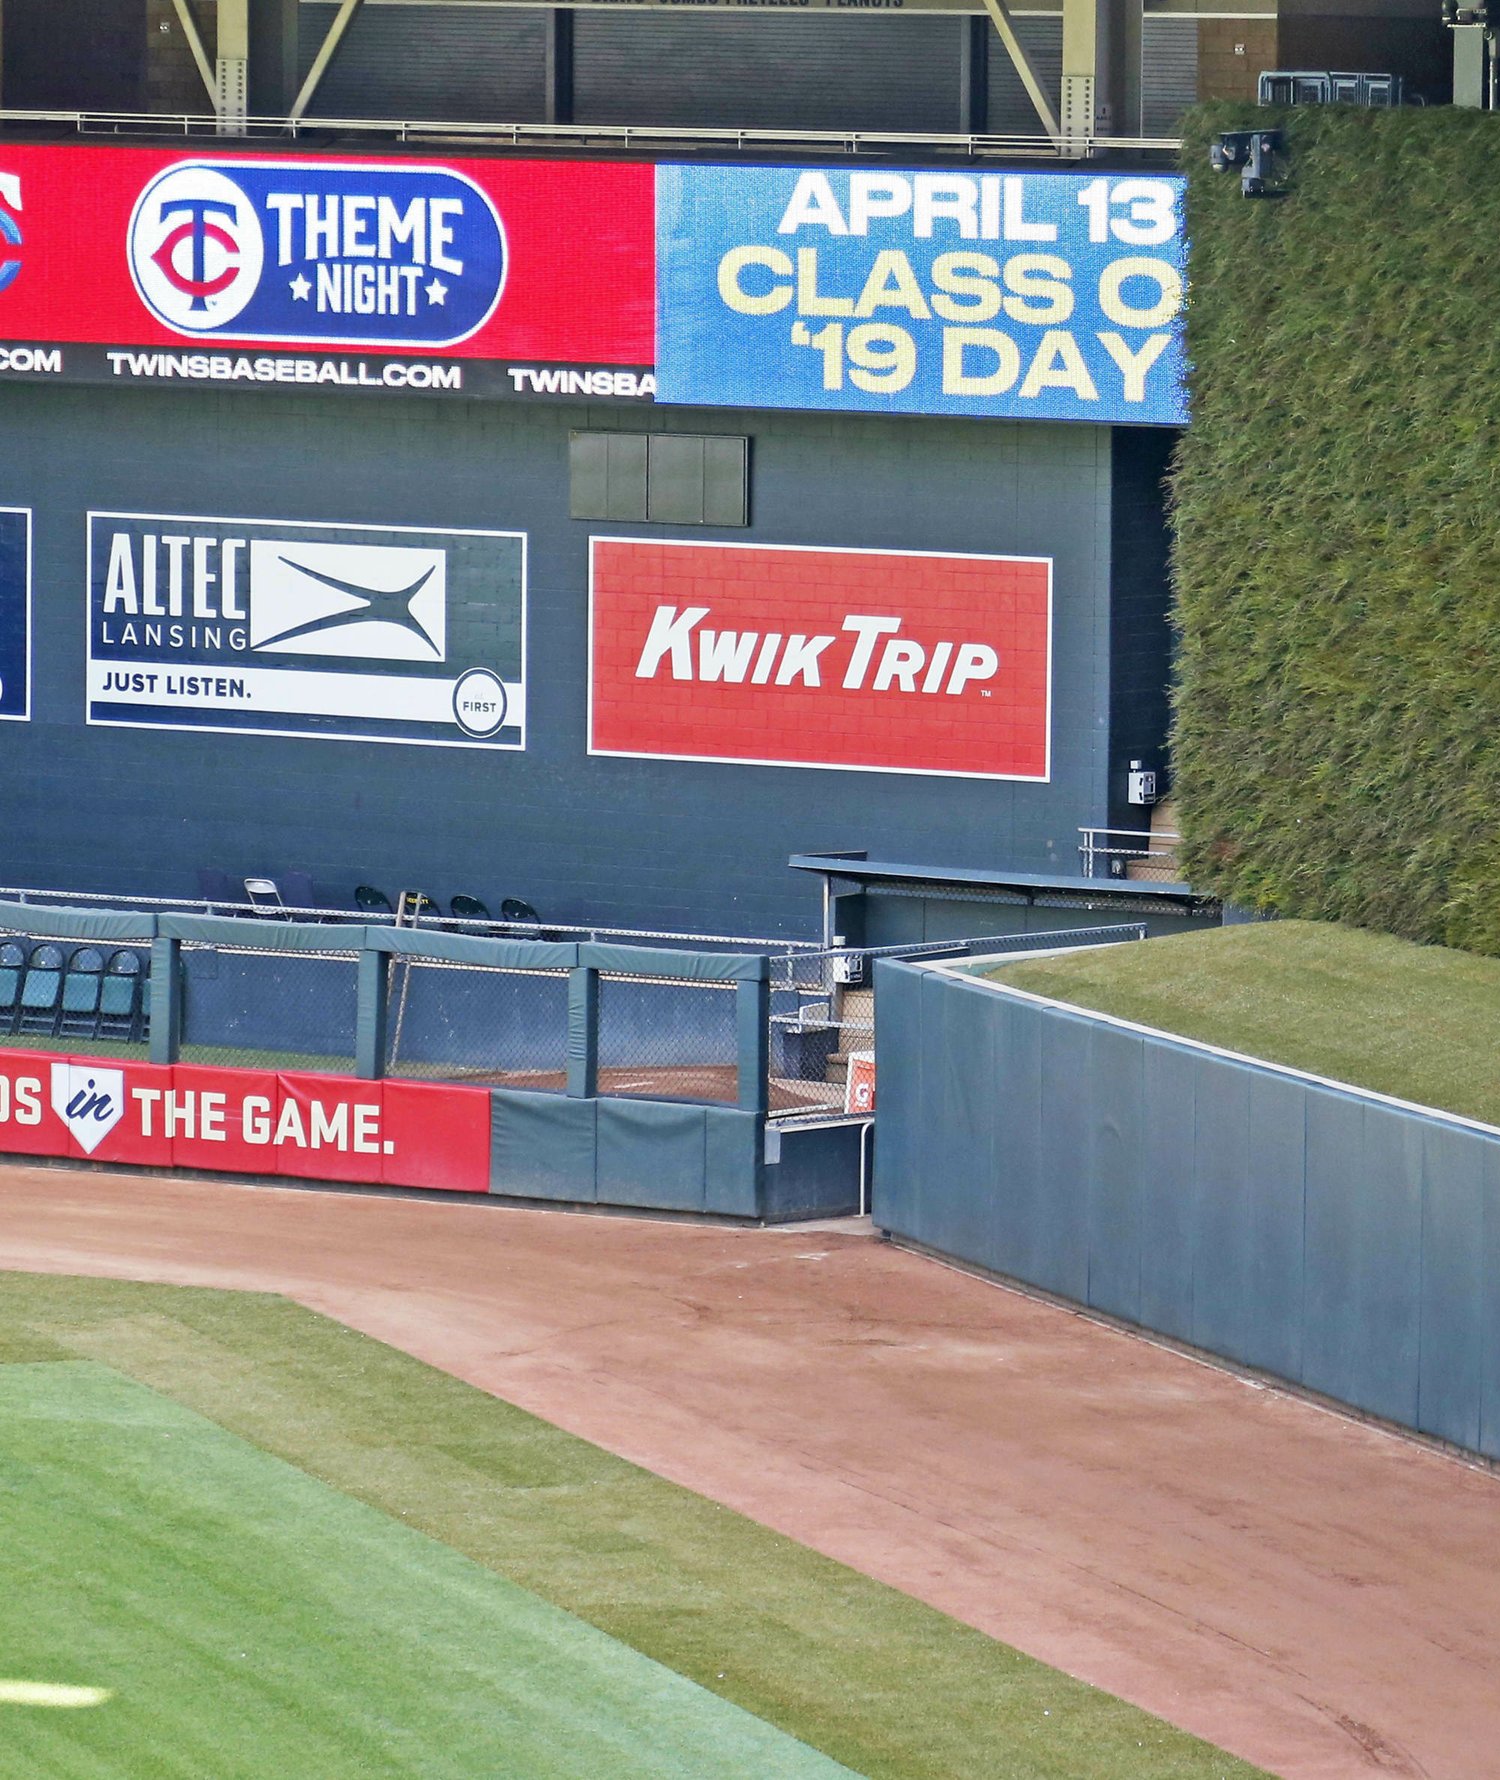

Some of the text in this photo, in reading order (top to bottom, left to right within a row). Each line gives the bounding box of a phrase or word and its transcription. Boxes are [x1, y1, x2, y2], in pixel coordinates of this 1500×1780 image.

[266, 193, 463, 275] THEME
[777, 172, 1176, 245] APRIL 13
[317, 265, 424, 316] NIGHT
[716, 245, 1075, 325] CLASS
[107, 352, 461, 389] TWINSBASEBALL.COM
[791, 323, 1169, 402] '19 DAY
[103, 533, 246, 620] ALTEC
[102, 621, 247, 651] LANSING
[102, 672, 252, 698] JUST LISTEN.
[463, 702, 496, 713] FIRST
[65, 1078, 117, 1122] in
[132, 1088, 227, 1141] THE
[242, 1095, 394, 1155] GAME.
